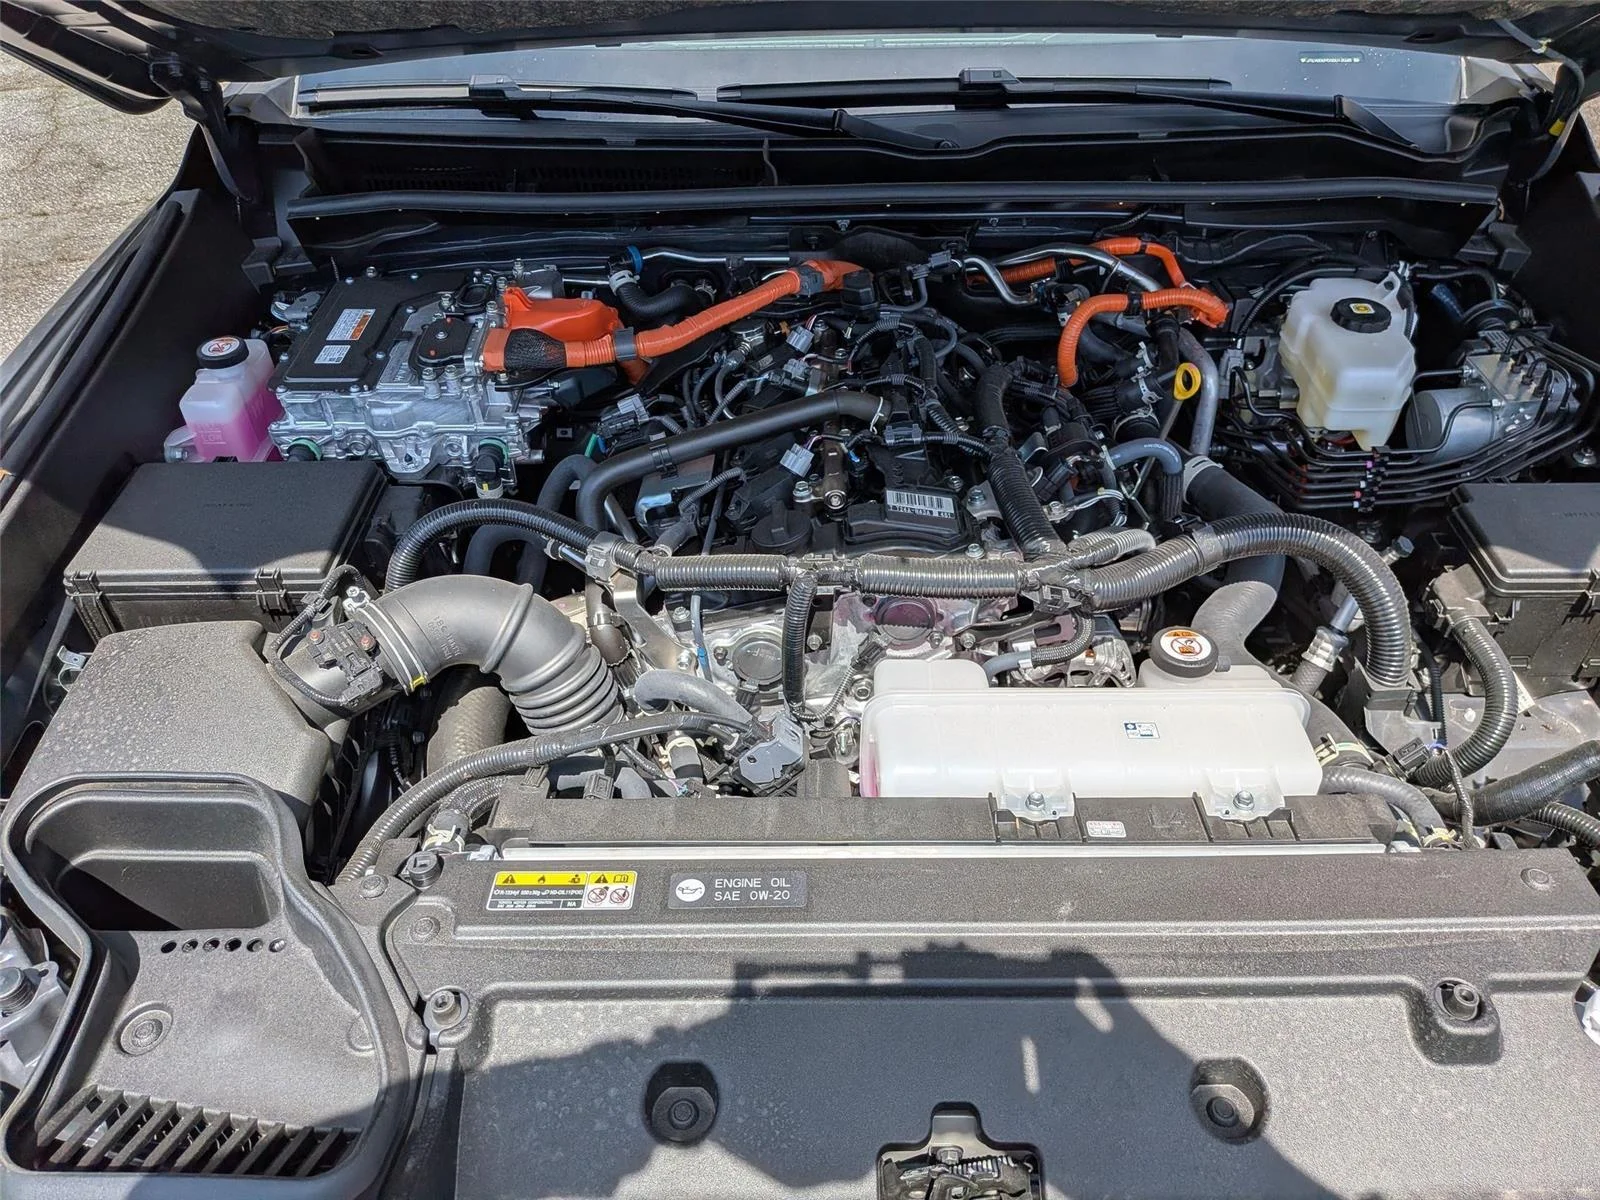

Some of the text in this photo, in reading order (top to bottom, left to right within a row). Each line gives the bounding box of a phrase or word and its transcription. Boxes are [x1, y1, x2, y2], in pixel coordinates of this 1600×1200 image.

[714, 877, 791, 889] ENGINE OIL
[713, 889, 791, 901] SAE 0W-20
